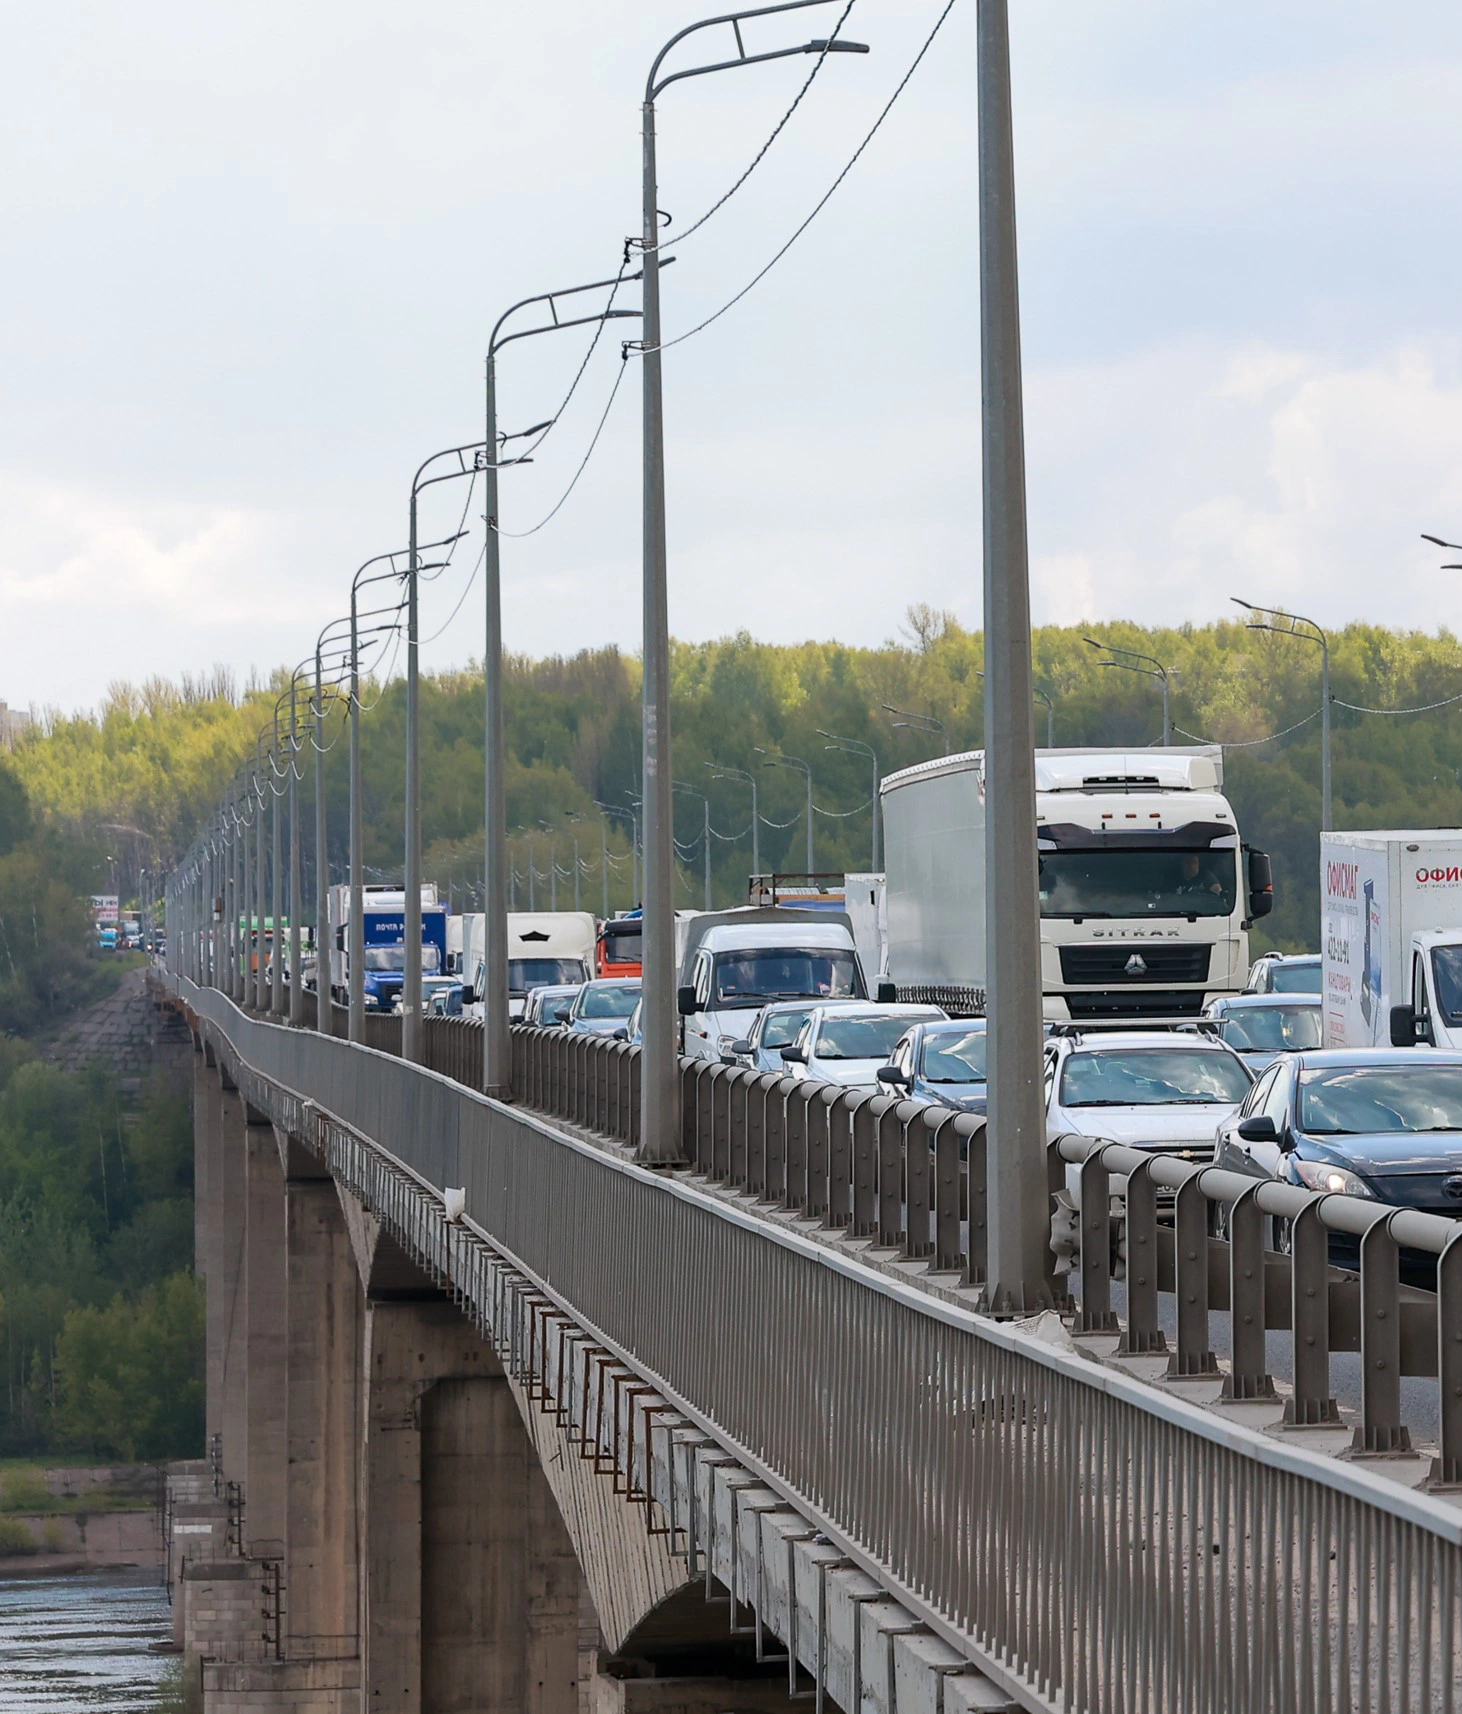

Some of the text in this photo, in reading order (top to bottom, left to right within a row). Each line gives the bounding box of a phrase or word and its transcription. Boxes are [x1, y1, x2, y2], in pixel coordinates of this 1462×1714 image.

[1327, 860, 1358, 900] ОФИСМАГ
[376, 923, 398, 931] ПОЧТА
[1092, 926, 1180, 937] SITRAK
